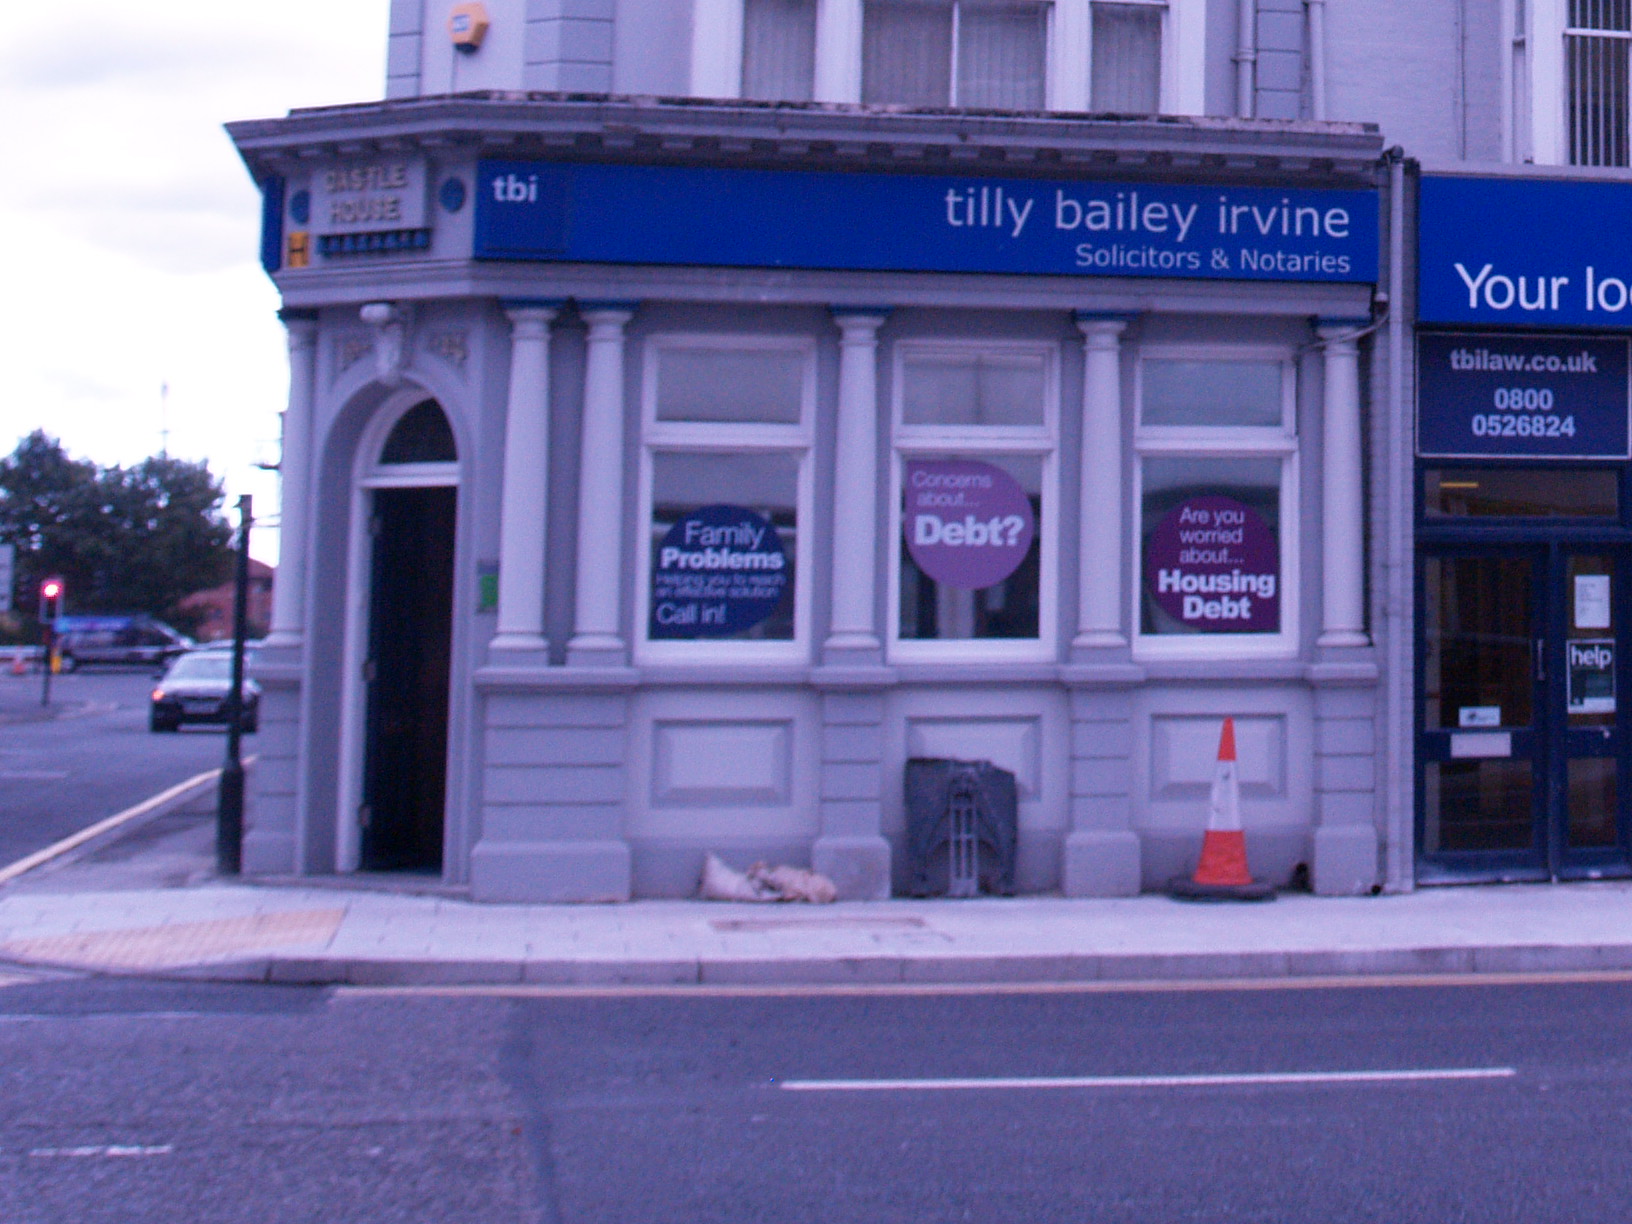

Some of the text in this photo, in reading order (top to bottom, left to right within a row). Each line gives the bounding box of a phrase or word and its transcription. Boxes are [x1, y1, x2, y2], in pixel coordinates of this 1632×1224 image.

[492, 174, 538, 203] tbi
[331, 194, 402, 223] HOUSE
[944, 186, 1350, 242] tilly bailey irvine
[1075, 242, 1351, 273] Solicitors & Notaries
[1454, 263, 1568, 311] Your
[1450, 349, 1598, 374] tbilaw.co.uk
[1493, 388, 1553, 410] 0800
[1471, 414, 1576, 438] 0526824
[912, 470, 993, 488] Concerns
[1180, 506, 1245, 527] Are you
[685, 519, 766, 551] Family
[914, 513, 1025, 547] Debt?
[1180, 528, 1243, 544] worried
[660, 545, 785, 569] Problems
[1158, 568, 1276, 598] Housing
[656, 602, 726, 625] Call in!
[1182, 595, 1252, 620] Debt
[1570, 644, 1612, 670] help
